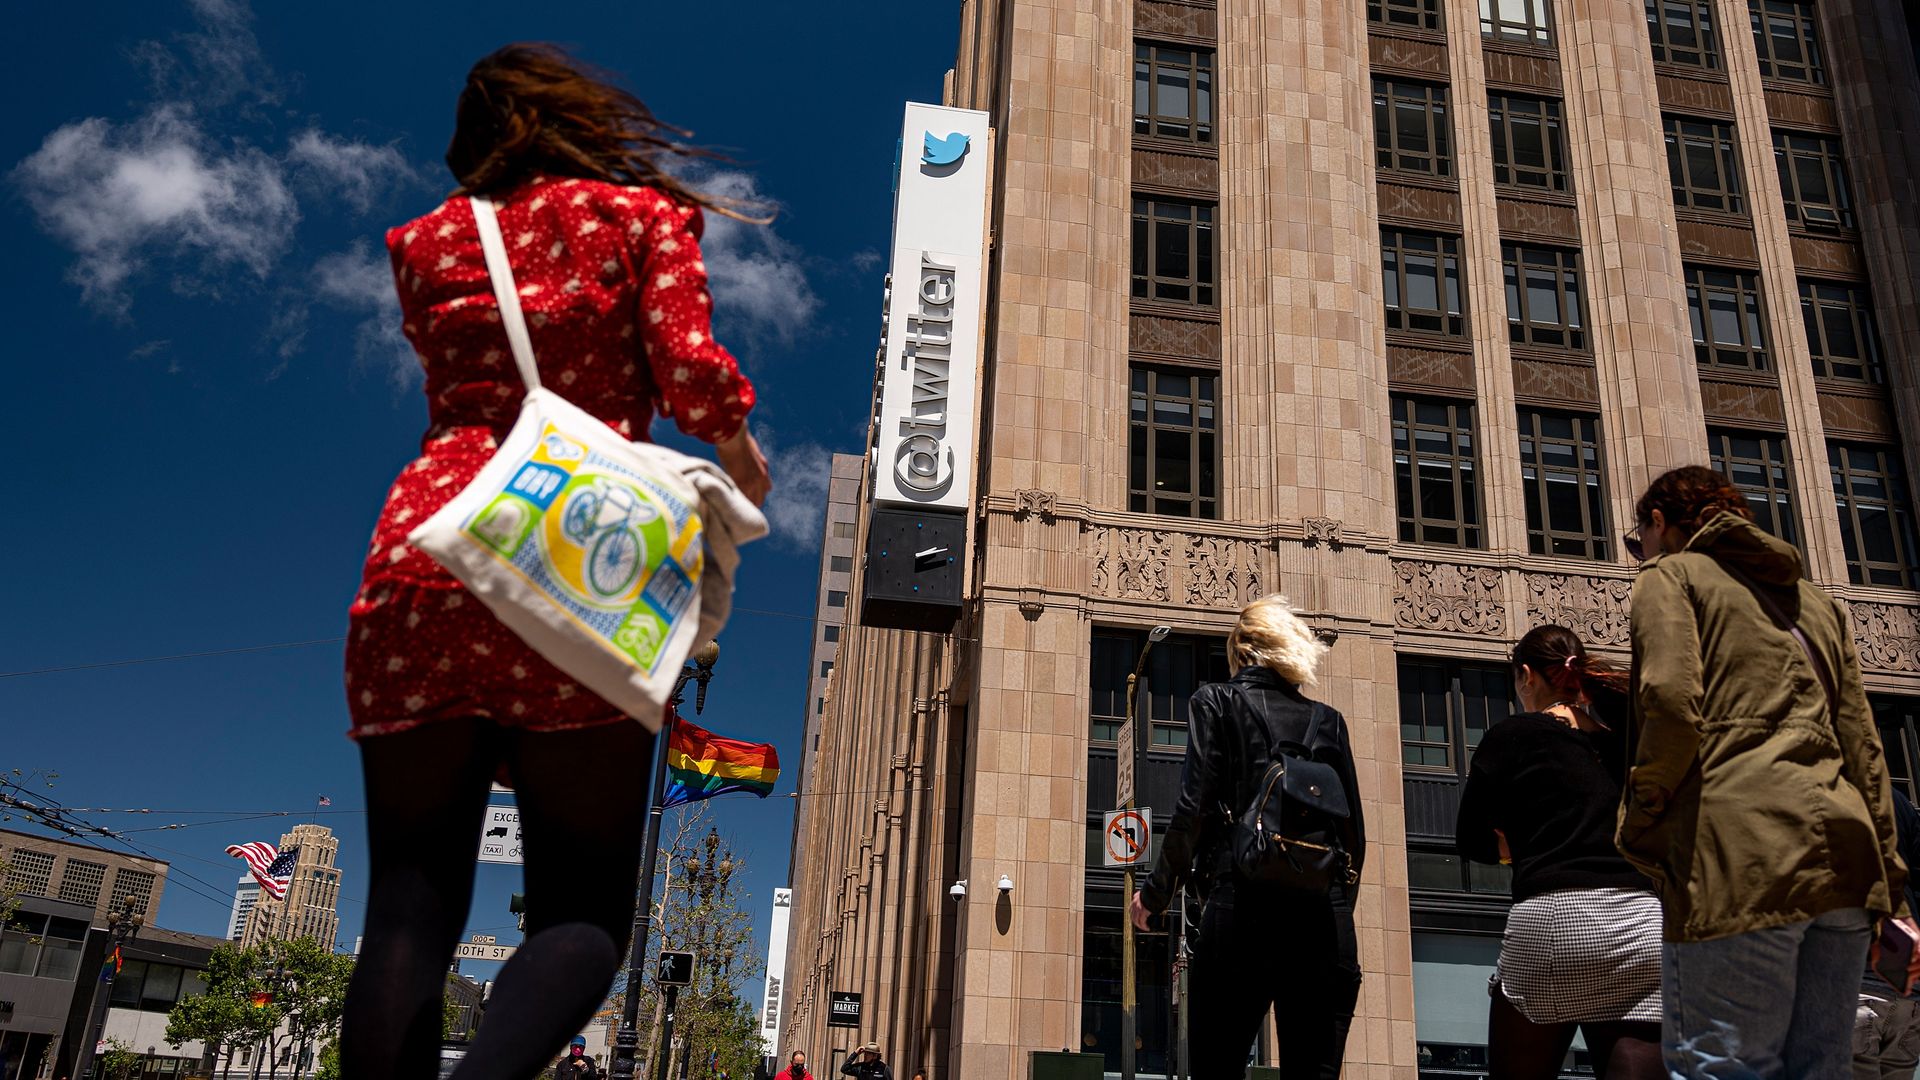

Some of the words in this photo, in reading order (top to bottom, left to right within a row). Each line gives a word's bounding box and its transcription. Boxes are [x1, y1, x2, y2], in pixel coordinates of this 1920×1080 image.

[893, 250, 956, 492] @twitter
[1118, 764, 1132, 800] 25
[493, 812, 520, 823] EXCE
[485, 846, 502, 854] TAXI
[458, 945, 485, 957] 10TH
[493, 948, 506, 958] ST
[766, 975, 781, 1029] DOLBY
[833, 1002, 860, 1013] MARKET
